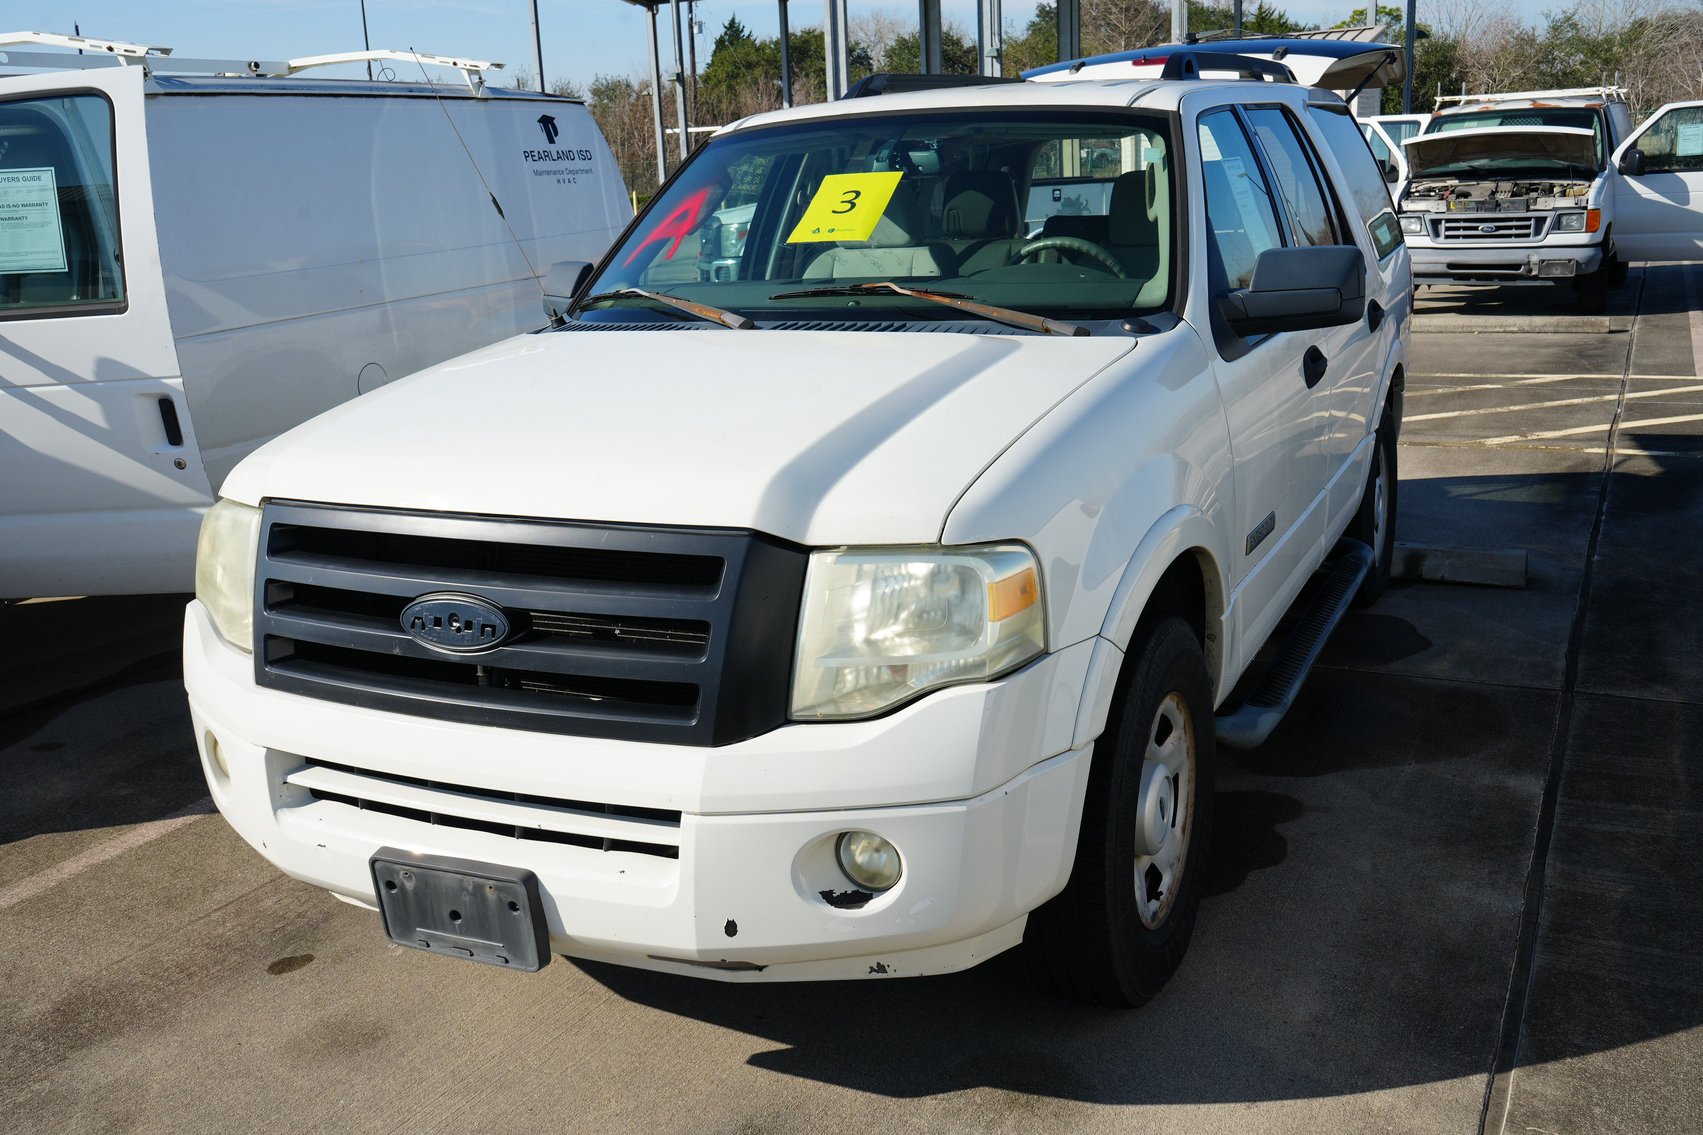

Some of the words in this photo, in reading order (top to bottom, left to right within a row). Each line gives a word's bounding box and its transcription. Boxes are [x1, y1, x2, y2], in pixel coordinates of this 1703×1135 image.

[523, 150, 575, 162] PEARLAND
[576, 149, 593, 161] ISD
[565, 168, 593, 176] Department
[832, 190, 861, 214] 3
[624, 187, 708, 267] A
